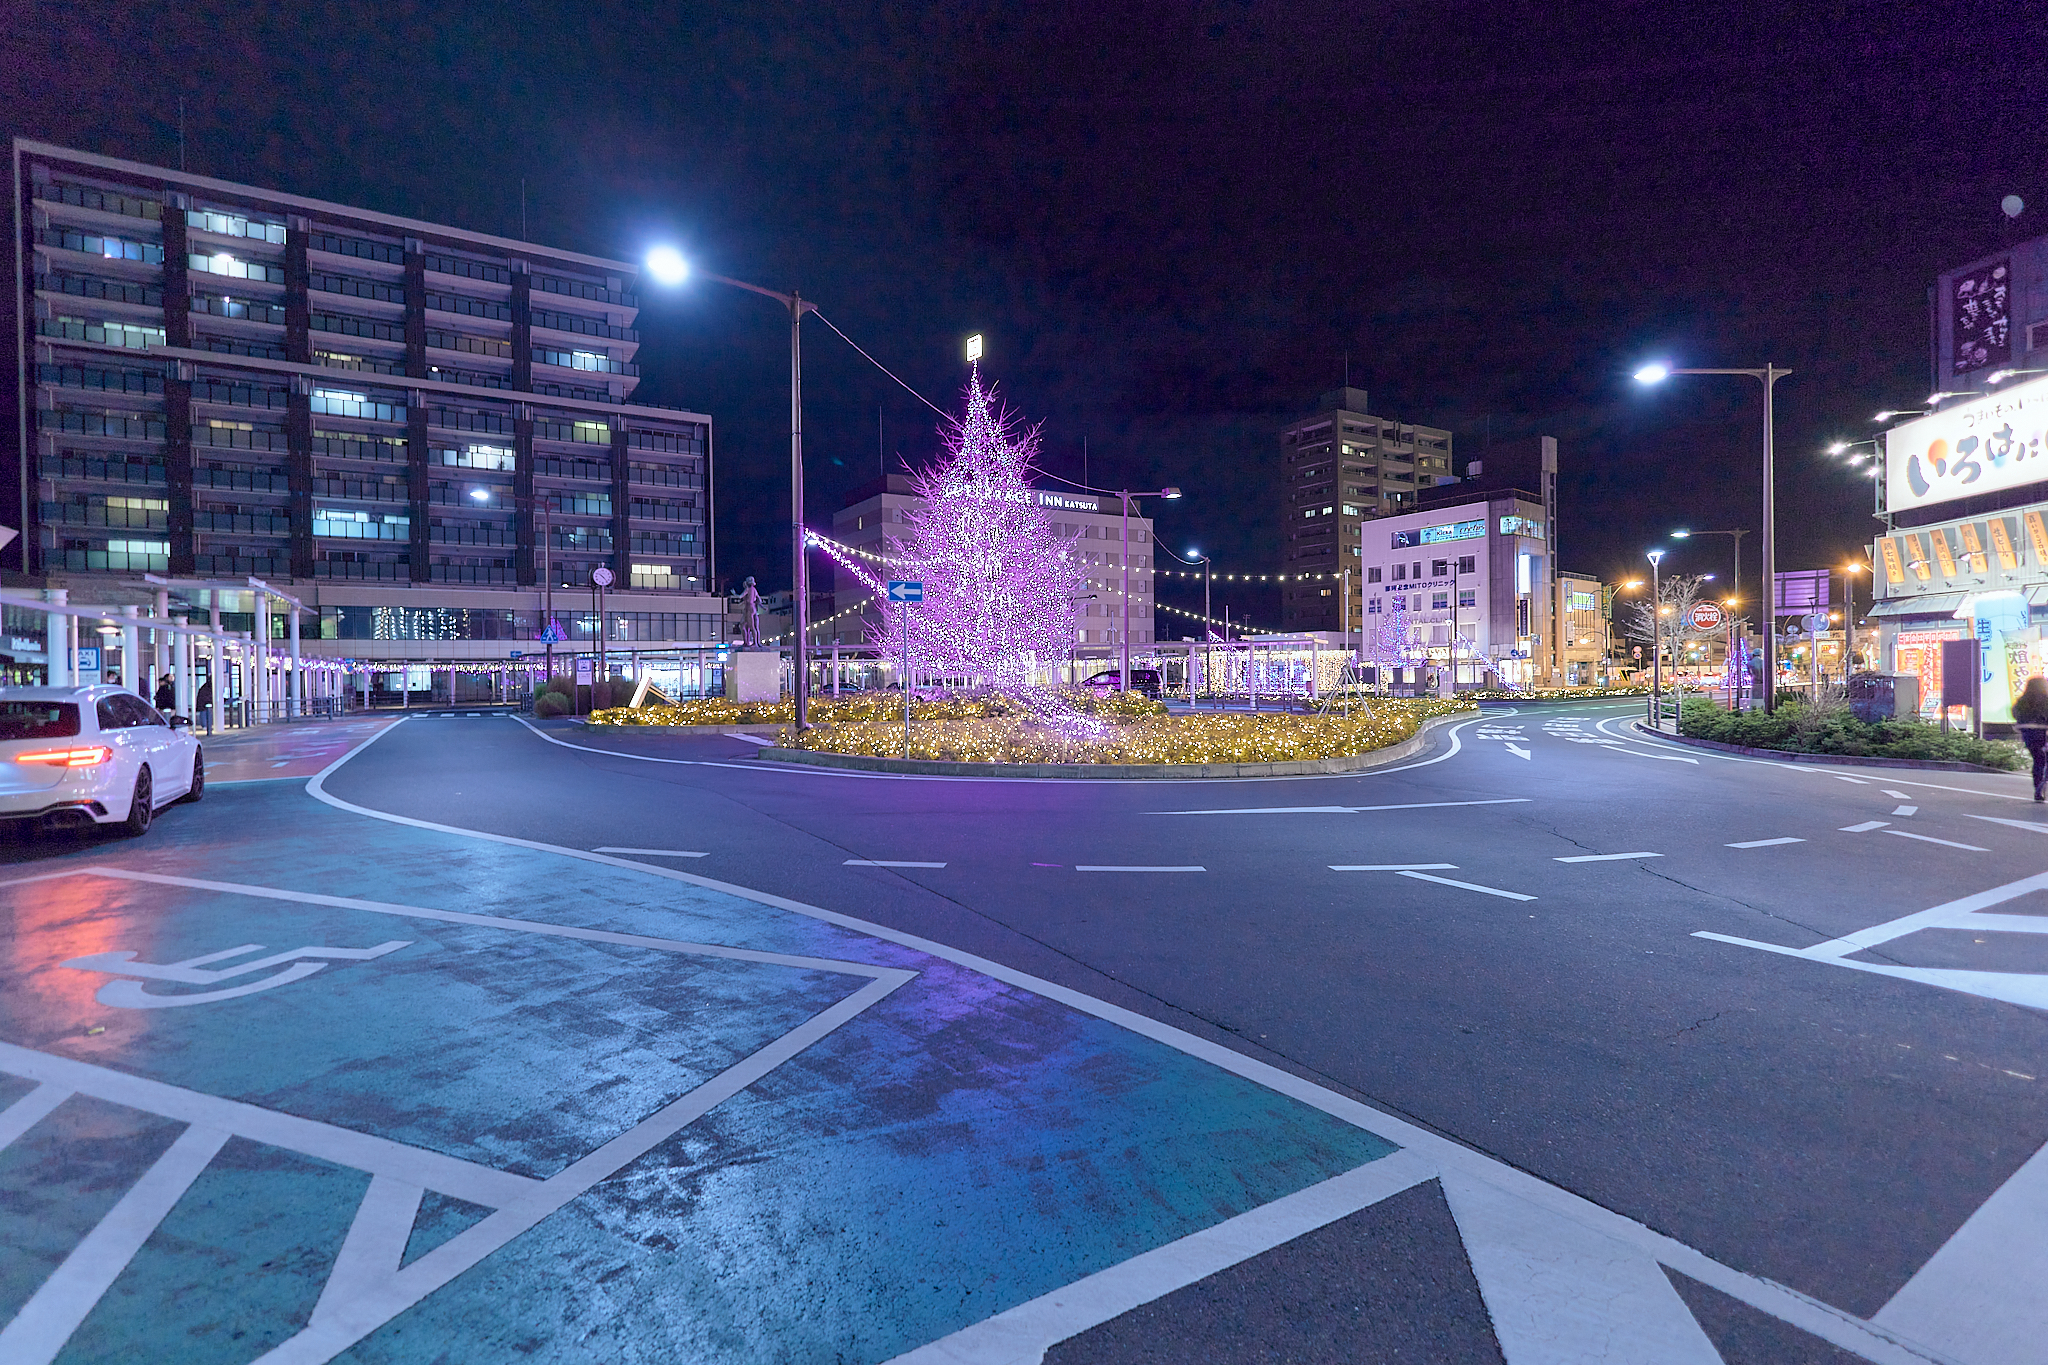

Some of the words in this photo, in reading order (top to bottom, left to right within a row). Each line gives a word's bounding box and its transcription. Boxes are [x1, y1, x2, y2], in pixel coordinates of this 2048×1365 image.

[1906, 422, 2048, 497] いろはに
[1039, 492, 1063, 508] INN
[1064, 500, 1098, 511] KATSUTA
[1993, 527, 2009, 557] 生ビール
[1695, 612, 1718, 622] 消火栓
